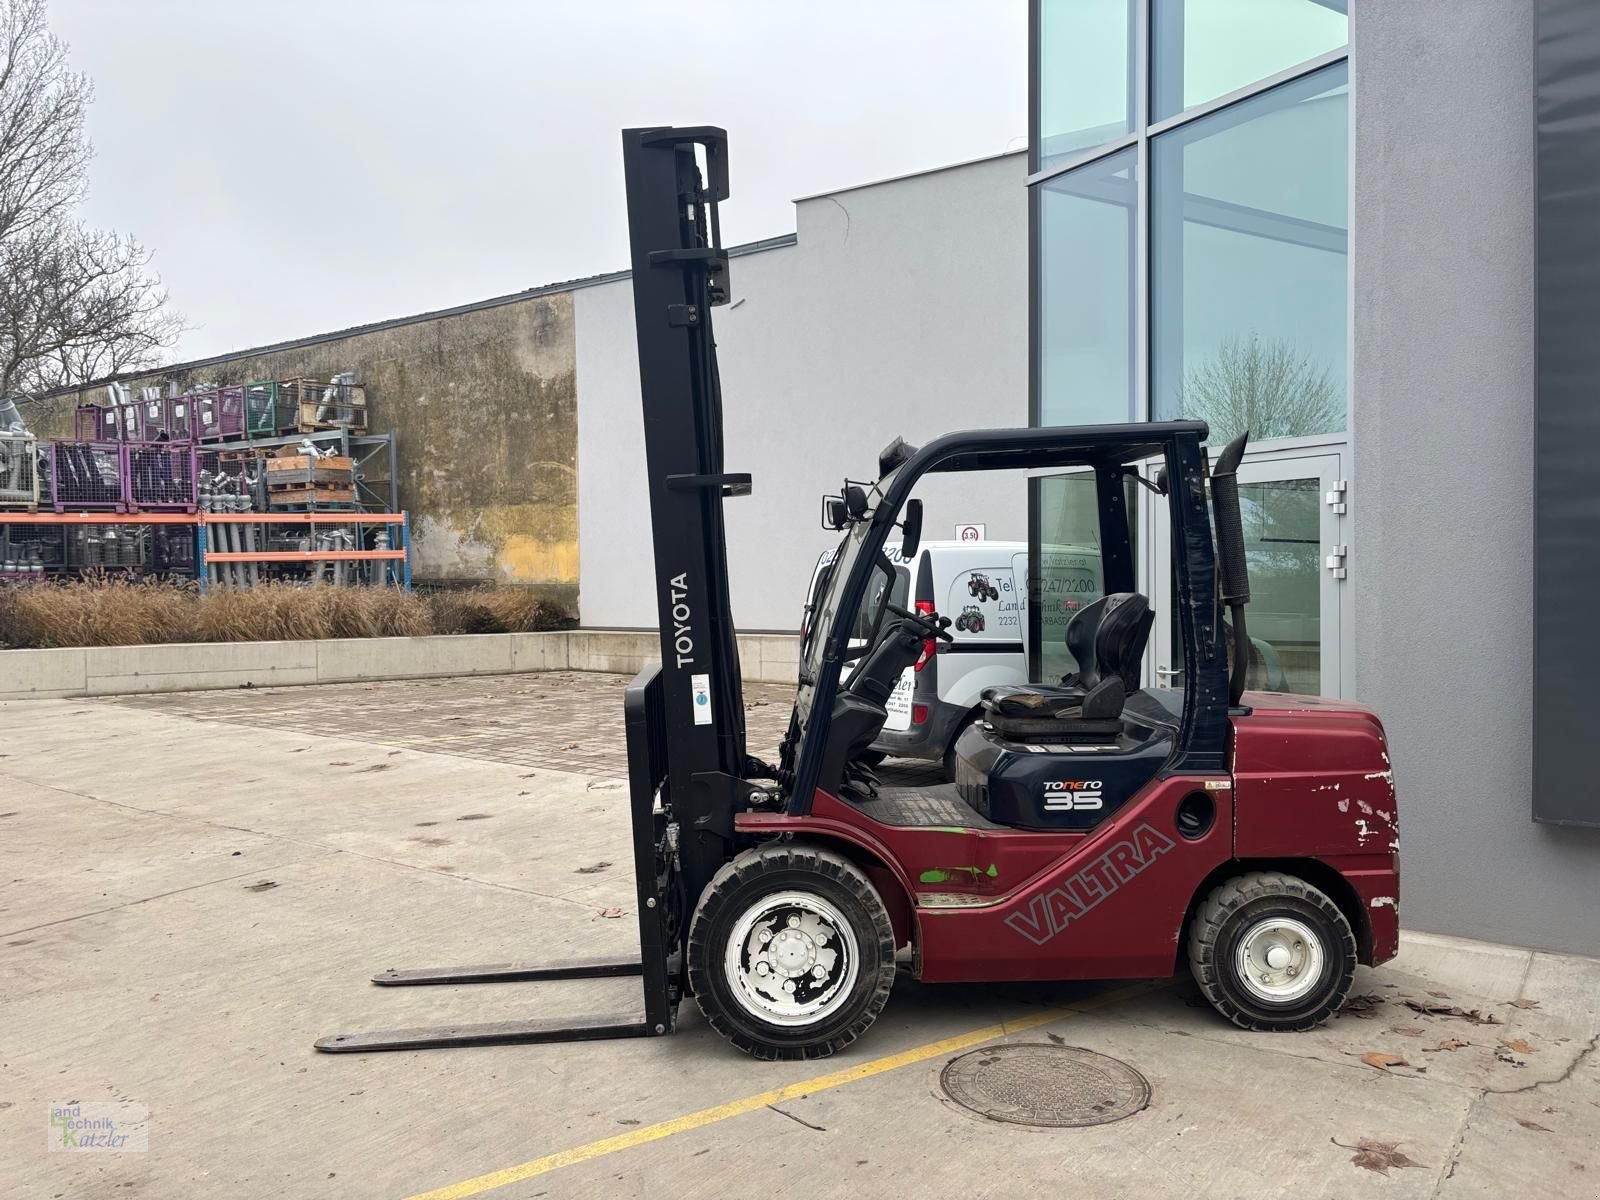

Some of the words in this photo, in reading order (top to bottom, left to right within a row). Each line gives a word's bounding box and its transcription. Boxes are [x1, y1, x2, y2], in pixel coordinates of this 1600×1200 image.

[670, 572, 694, 669] TOYOTA
[999, 617, 1018, 626] 2232
[1044, 791, 1103, 811] 35
[1004, 824, 1176, 944] VALTRA
